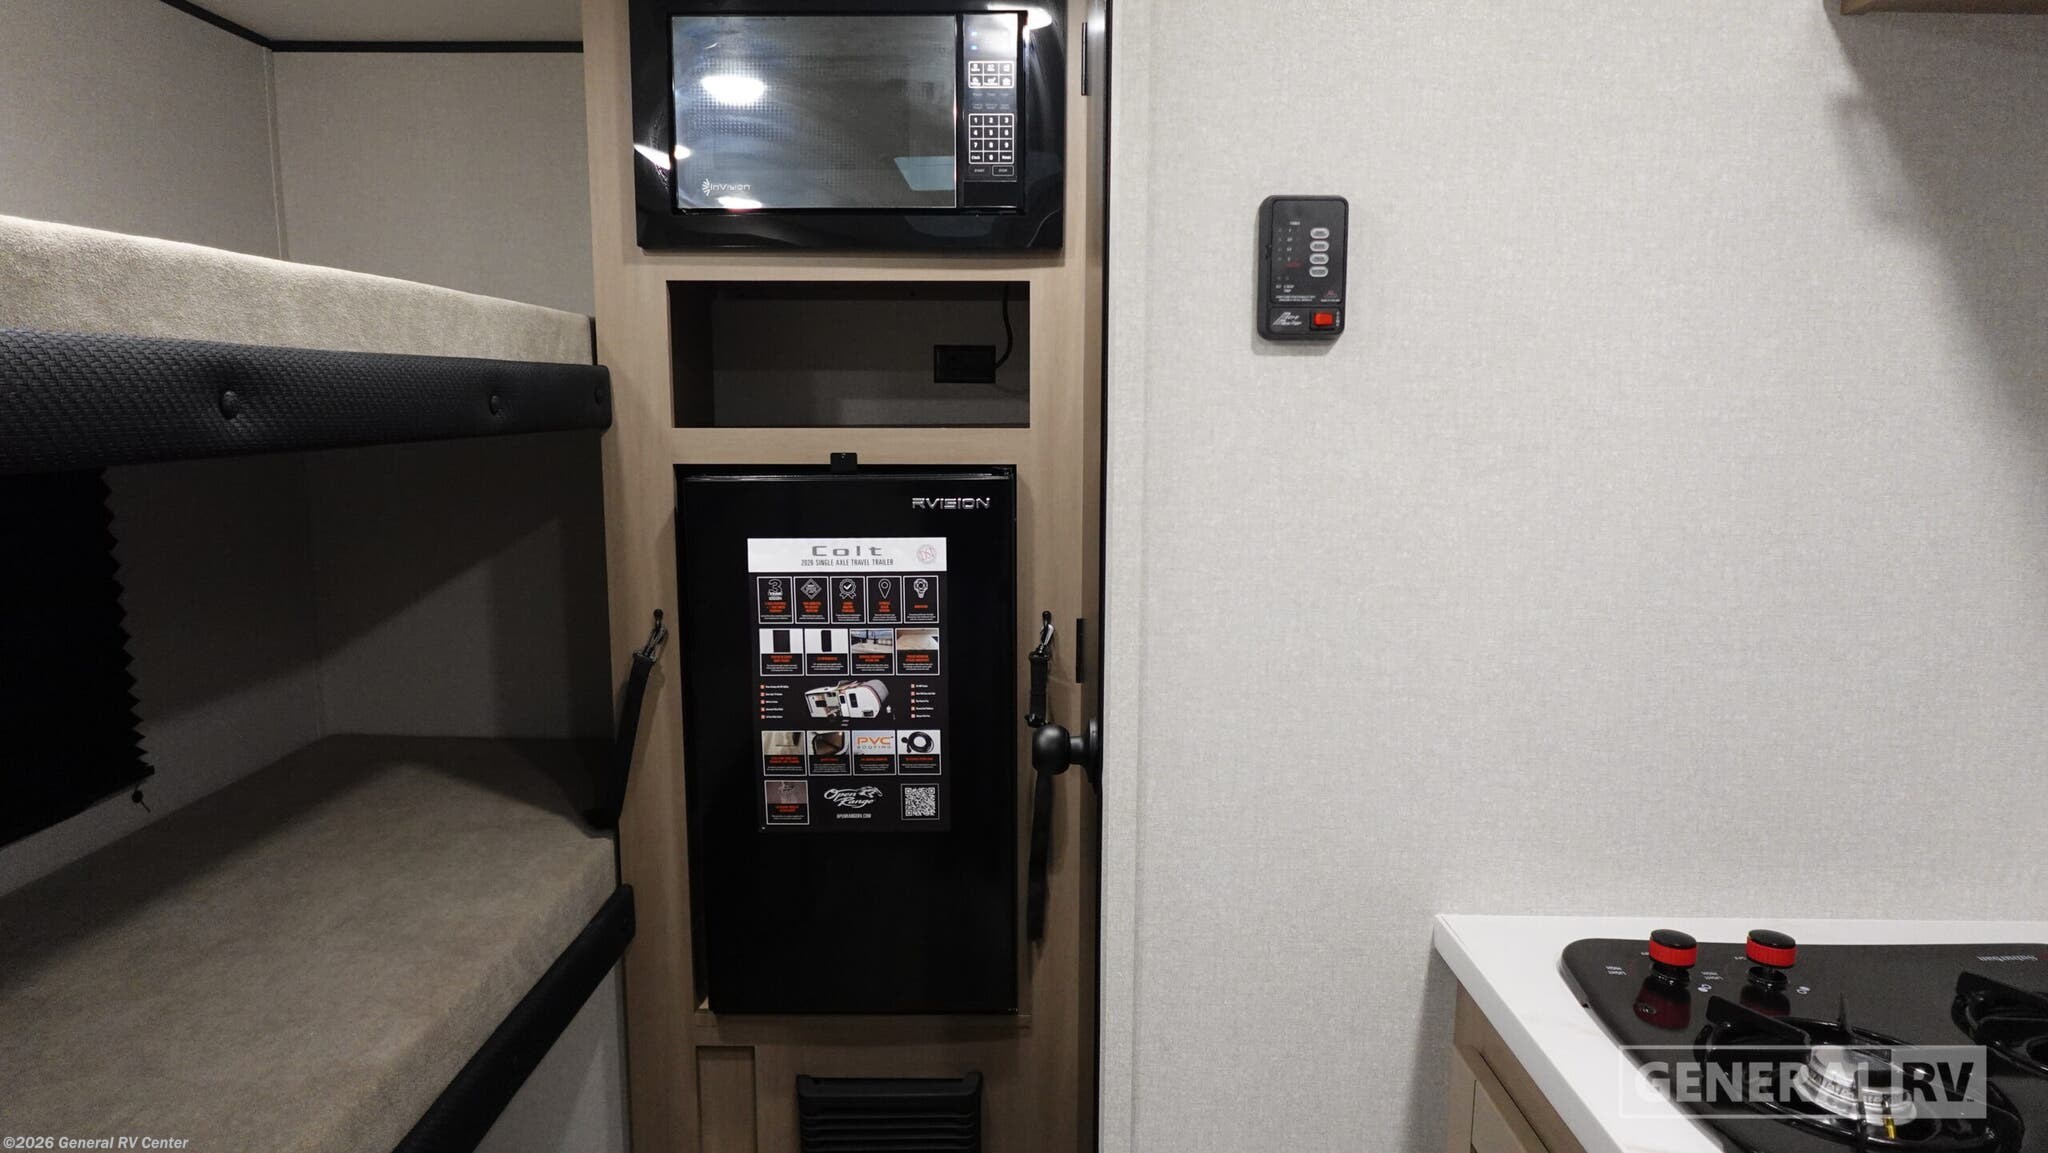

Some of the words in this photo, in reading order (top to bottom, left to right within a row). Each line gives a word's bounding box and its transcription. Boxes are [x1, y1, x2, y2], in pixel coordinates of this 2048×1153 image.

[912, 497, 990, 509] RVISION
[812, 545, 882, 557] Colt
[851, 558, 870, 566] TRAVEL
[872, 558, 894, 566] TRAILER
[857, 736, 891, 745] PVC
[824, 788, 857, 802] Open
[834, 796, 874, 809] Range
